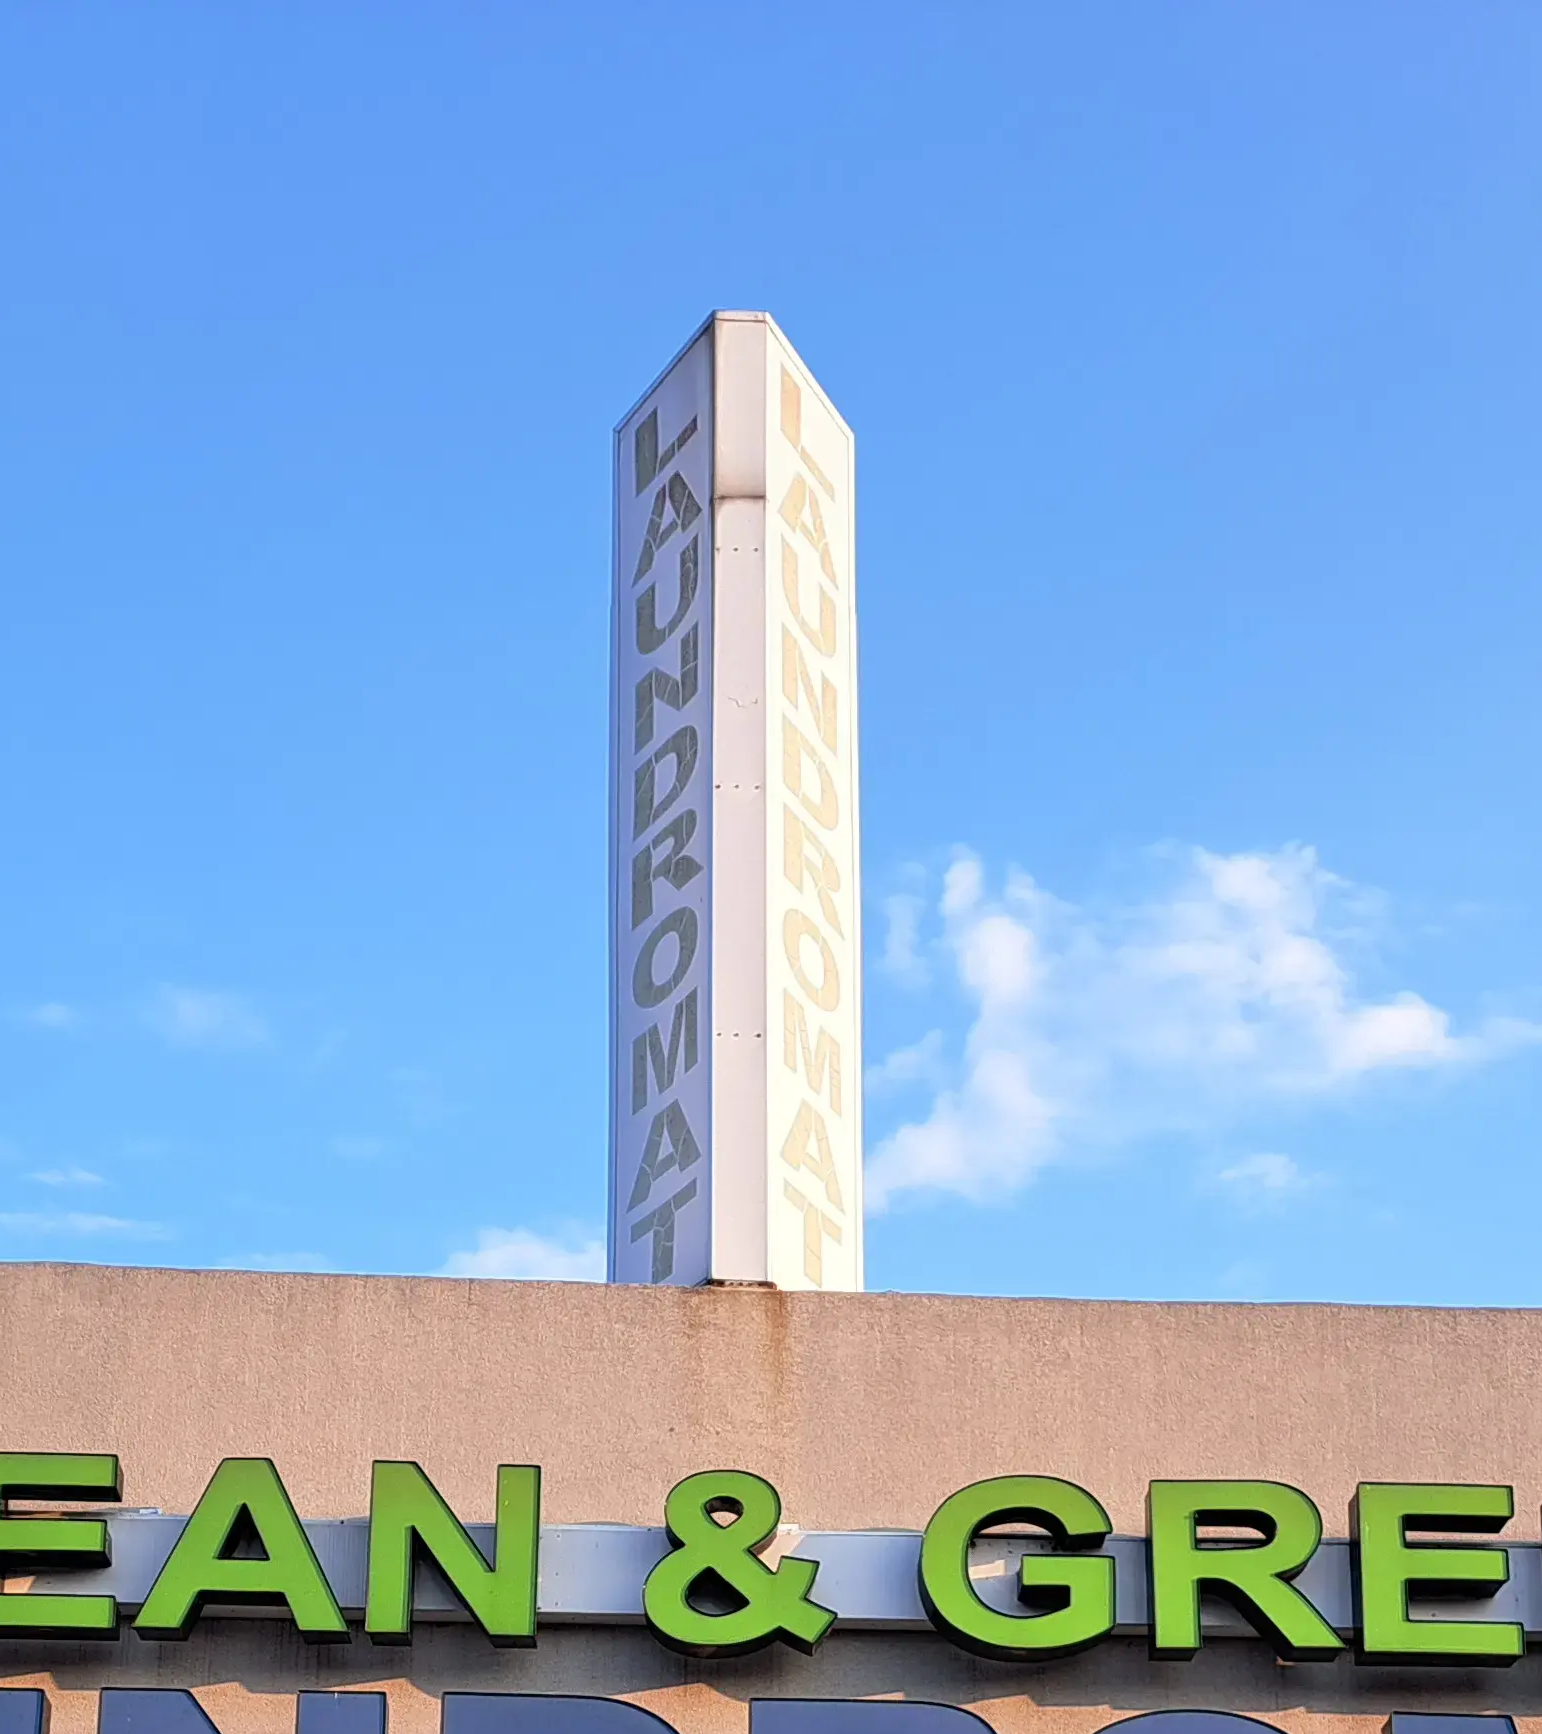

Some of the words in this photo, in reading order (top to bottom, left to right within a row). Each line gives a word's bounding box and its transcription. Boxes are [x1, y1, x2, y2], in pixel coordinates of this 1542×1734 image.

[627, 407, 704, 1284] LAUNDROMAT
[778, 362, 845, 1288] LAUNDROMAT
[643, 1469, 836, 1659] &
